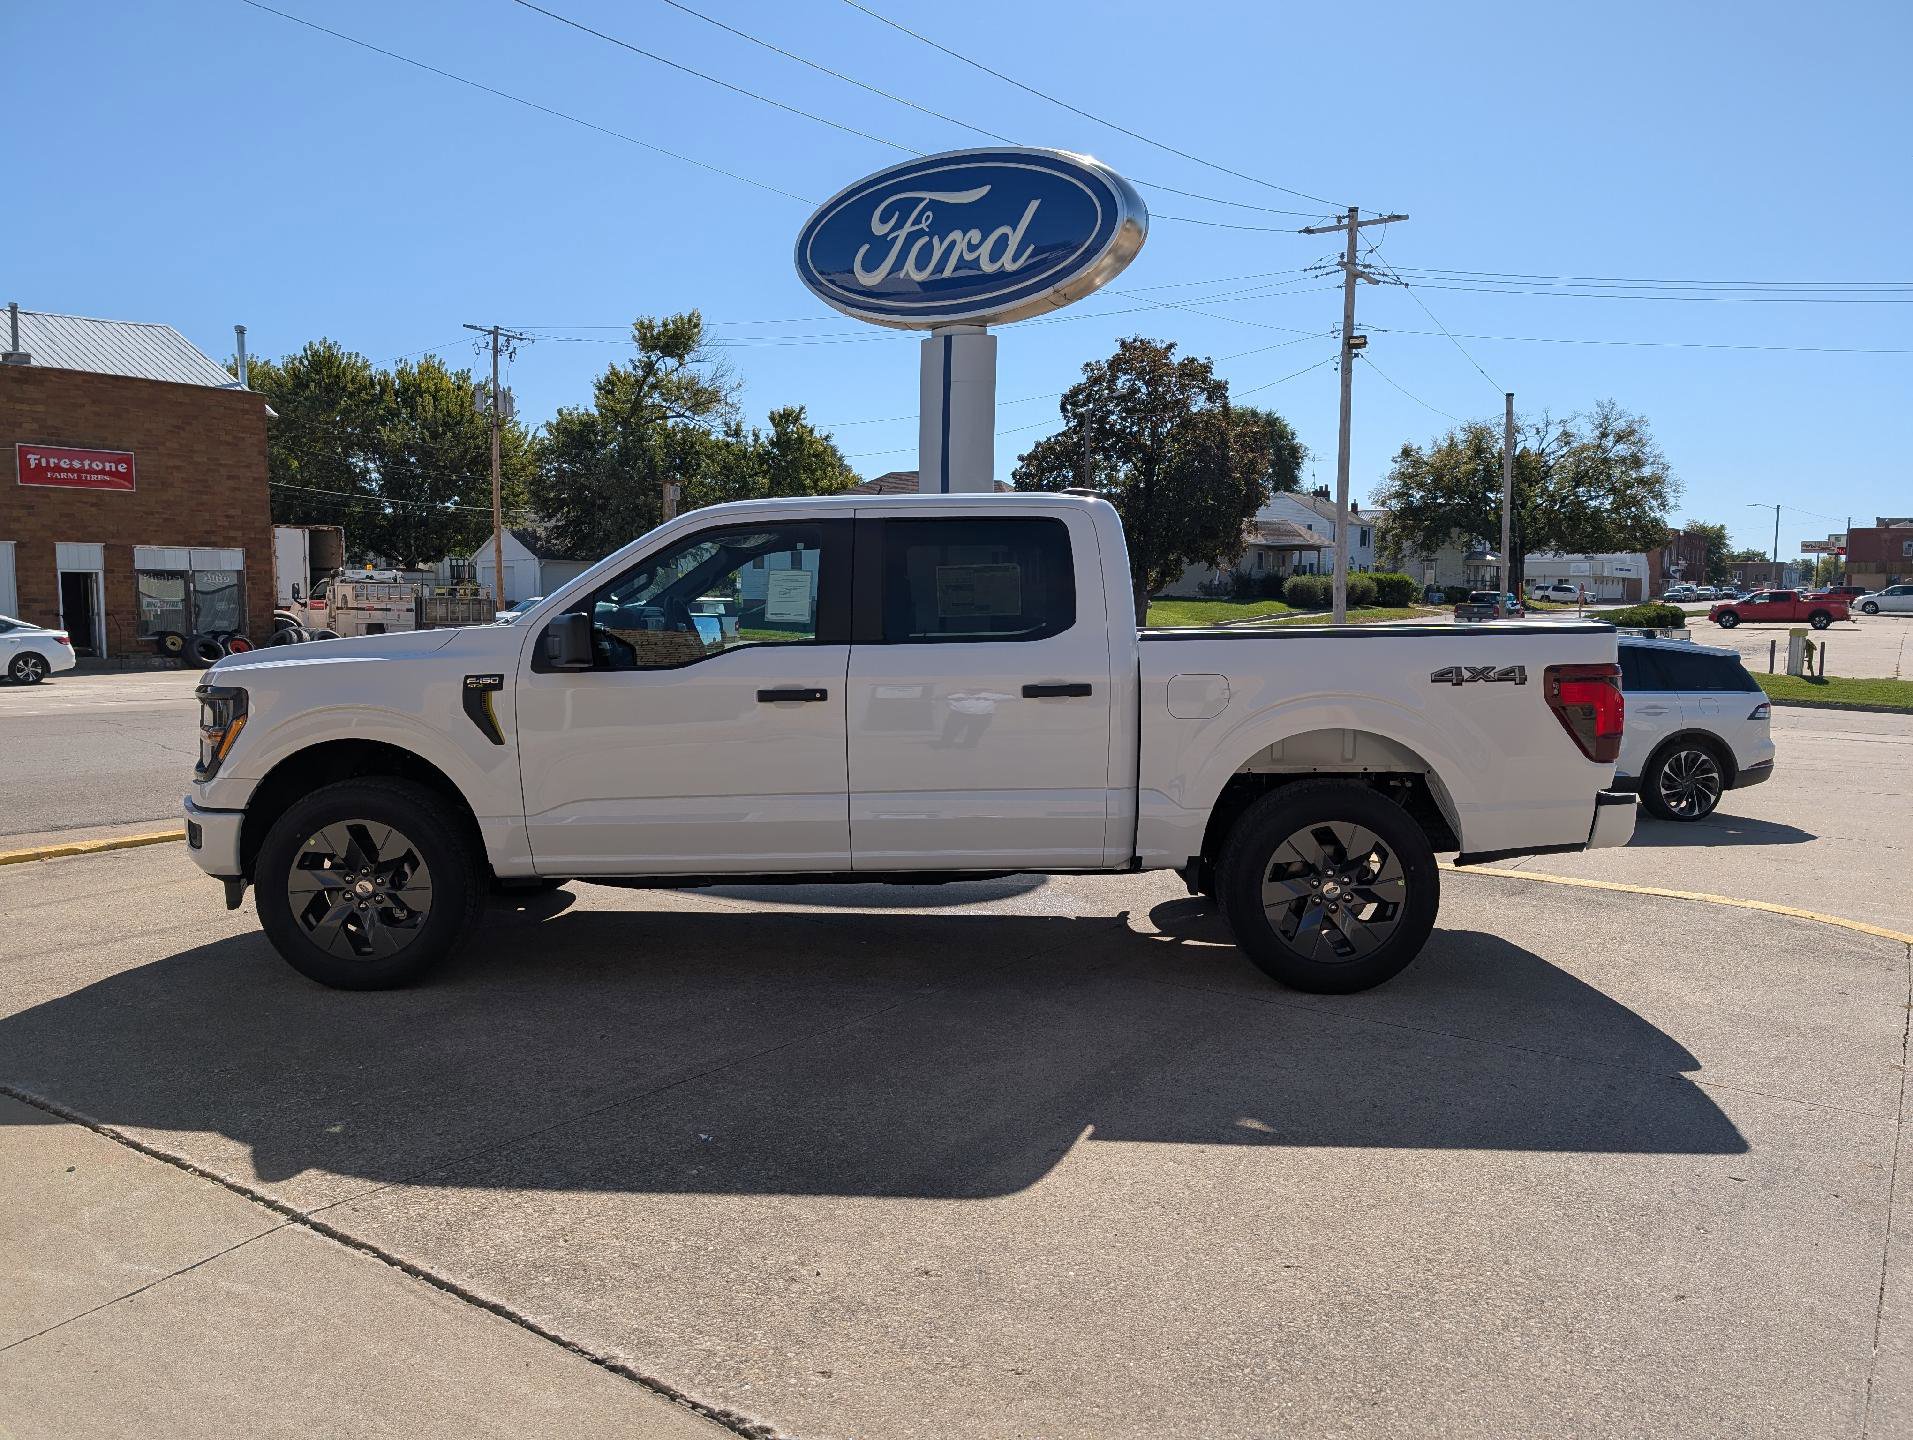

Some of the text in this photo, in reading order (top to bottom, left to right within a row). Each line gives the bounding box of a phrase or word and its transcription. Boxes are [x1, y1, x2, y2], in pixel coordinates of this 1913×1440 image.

[853, 184, 1041, 286] Ford
[27, 453, 128, 473] Firestone
[47, 471, 110, 481] FARM TIRES
